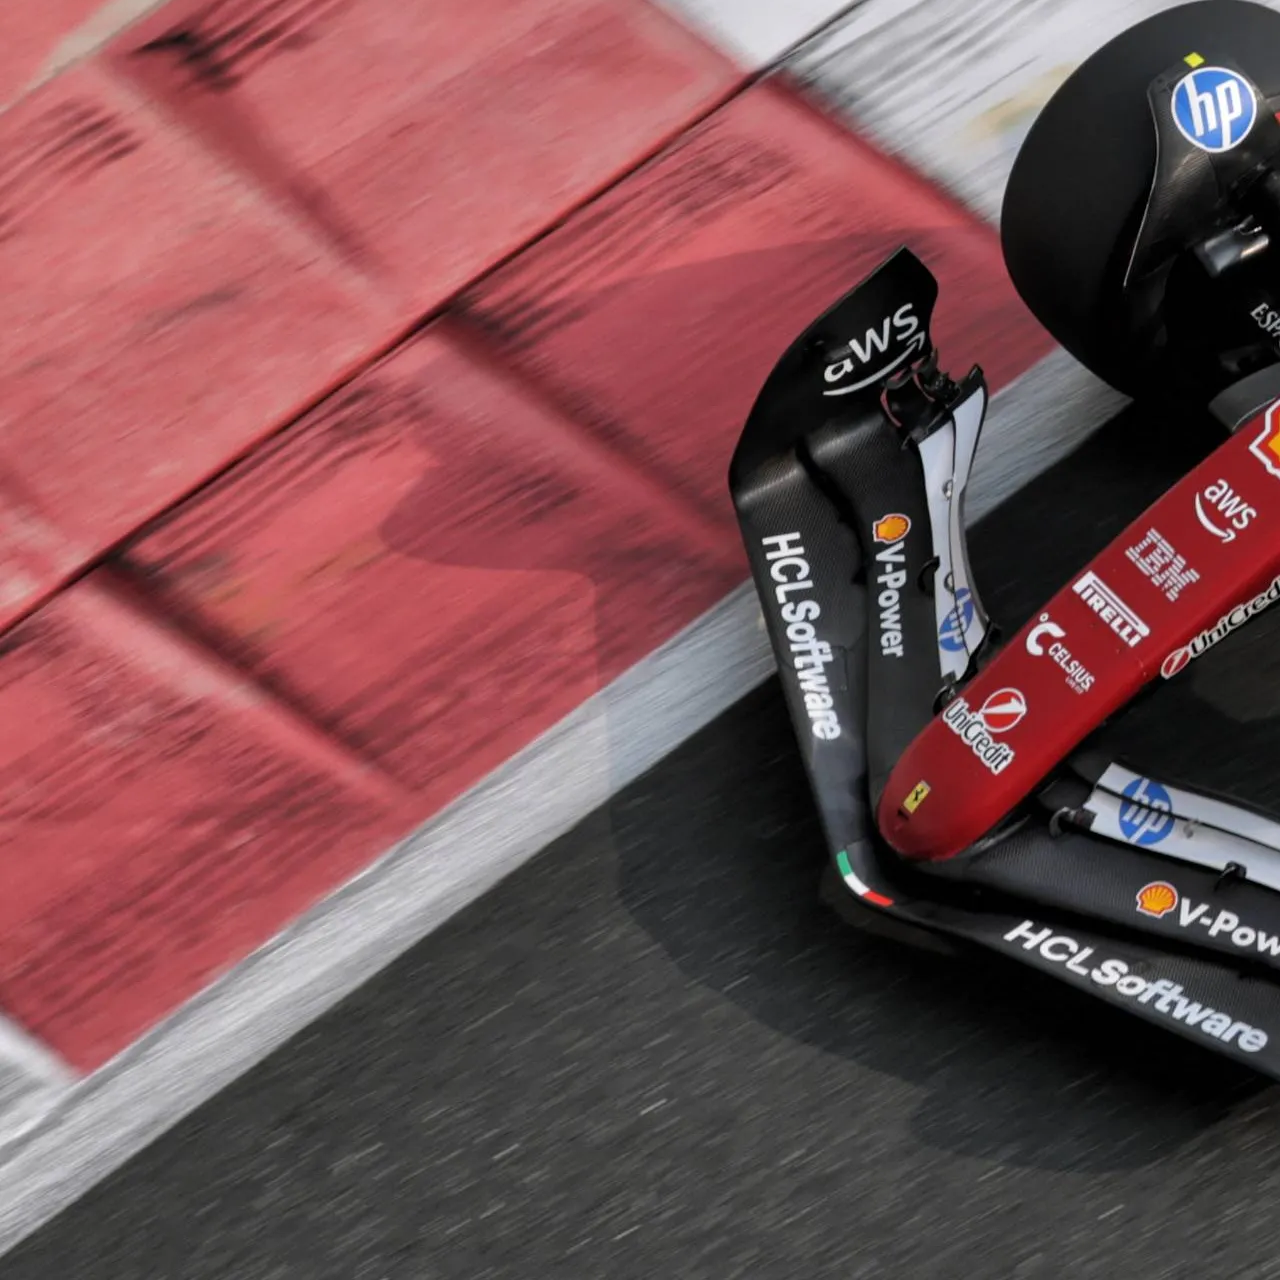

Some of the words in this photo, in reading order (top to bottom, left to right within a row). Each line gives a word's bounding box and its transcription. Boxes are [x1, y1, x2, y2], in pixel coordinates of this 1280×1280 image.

[1178, 69, 1248, 151] hp
[823, 303, 919, 383] aws
[1204, 479, 1257, 530] aws
[872, 542, 907, 658] V-Power
[1124, 528, 1201, 602] IBM
[762, 532, 841, 741] HCLSoftware
[1072, 571, 1150, 648] PIRELLI
[1048, 642, 1095, 692] CELSIUS
[943, 698, 1016, 774] UniCredit
[1119, 777, 1174, 843] hp
[1004, 919, 1268, 1052] HCLSoftware
